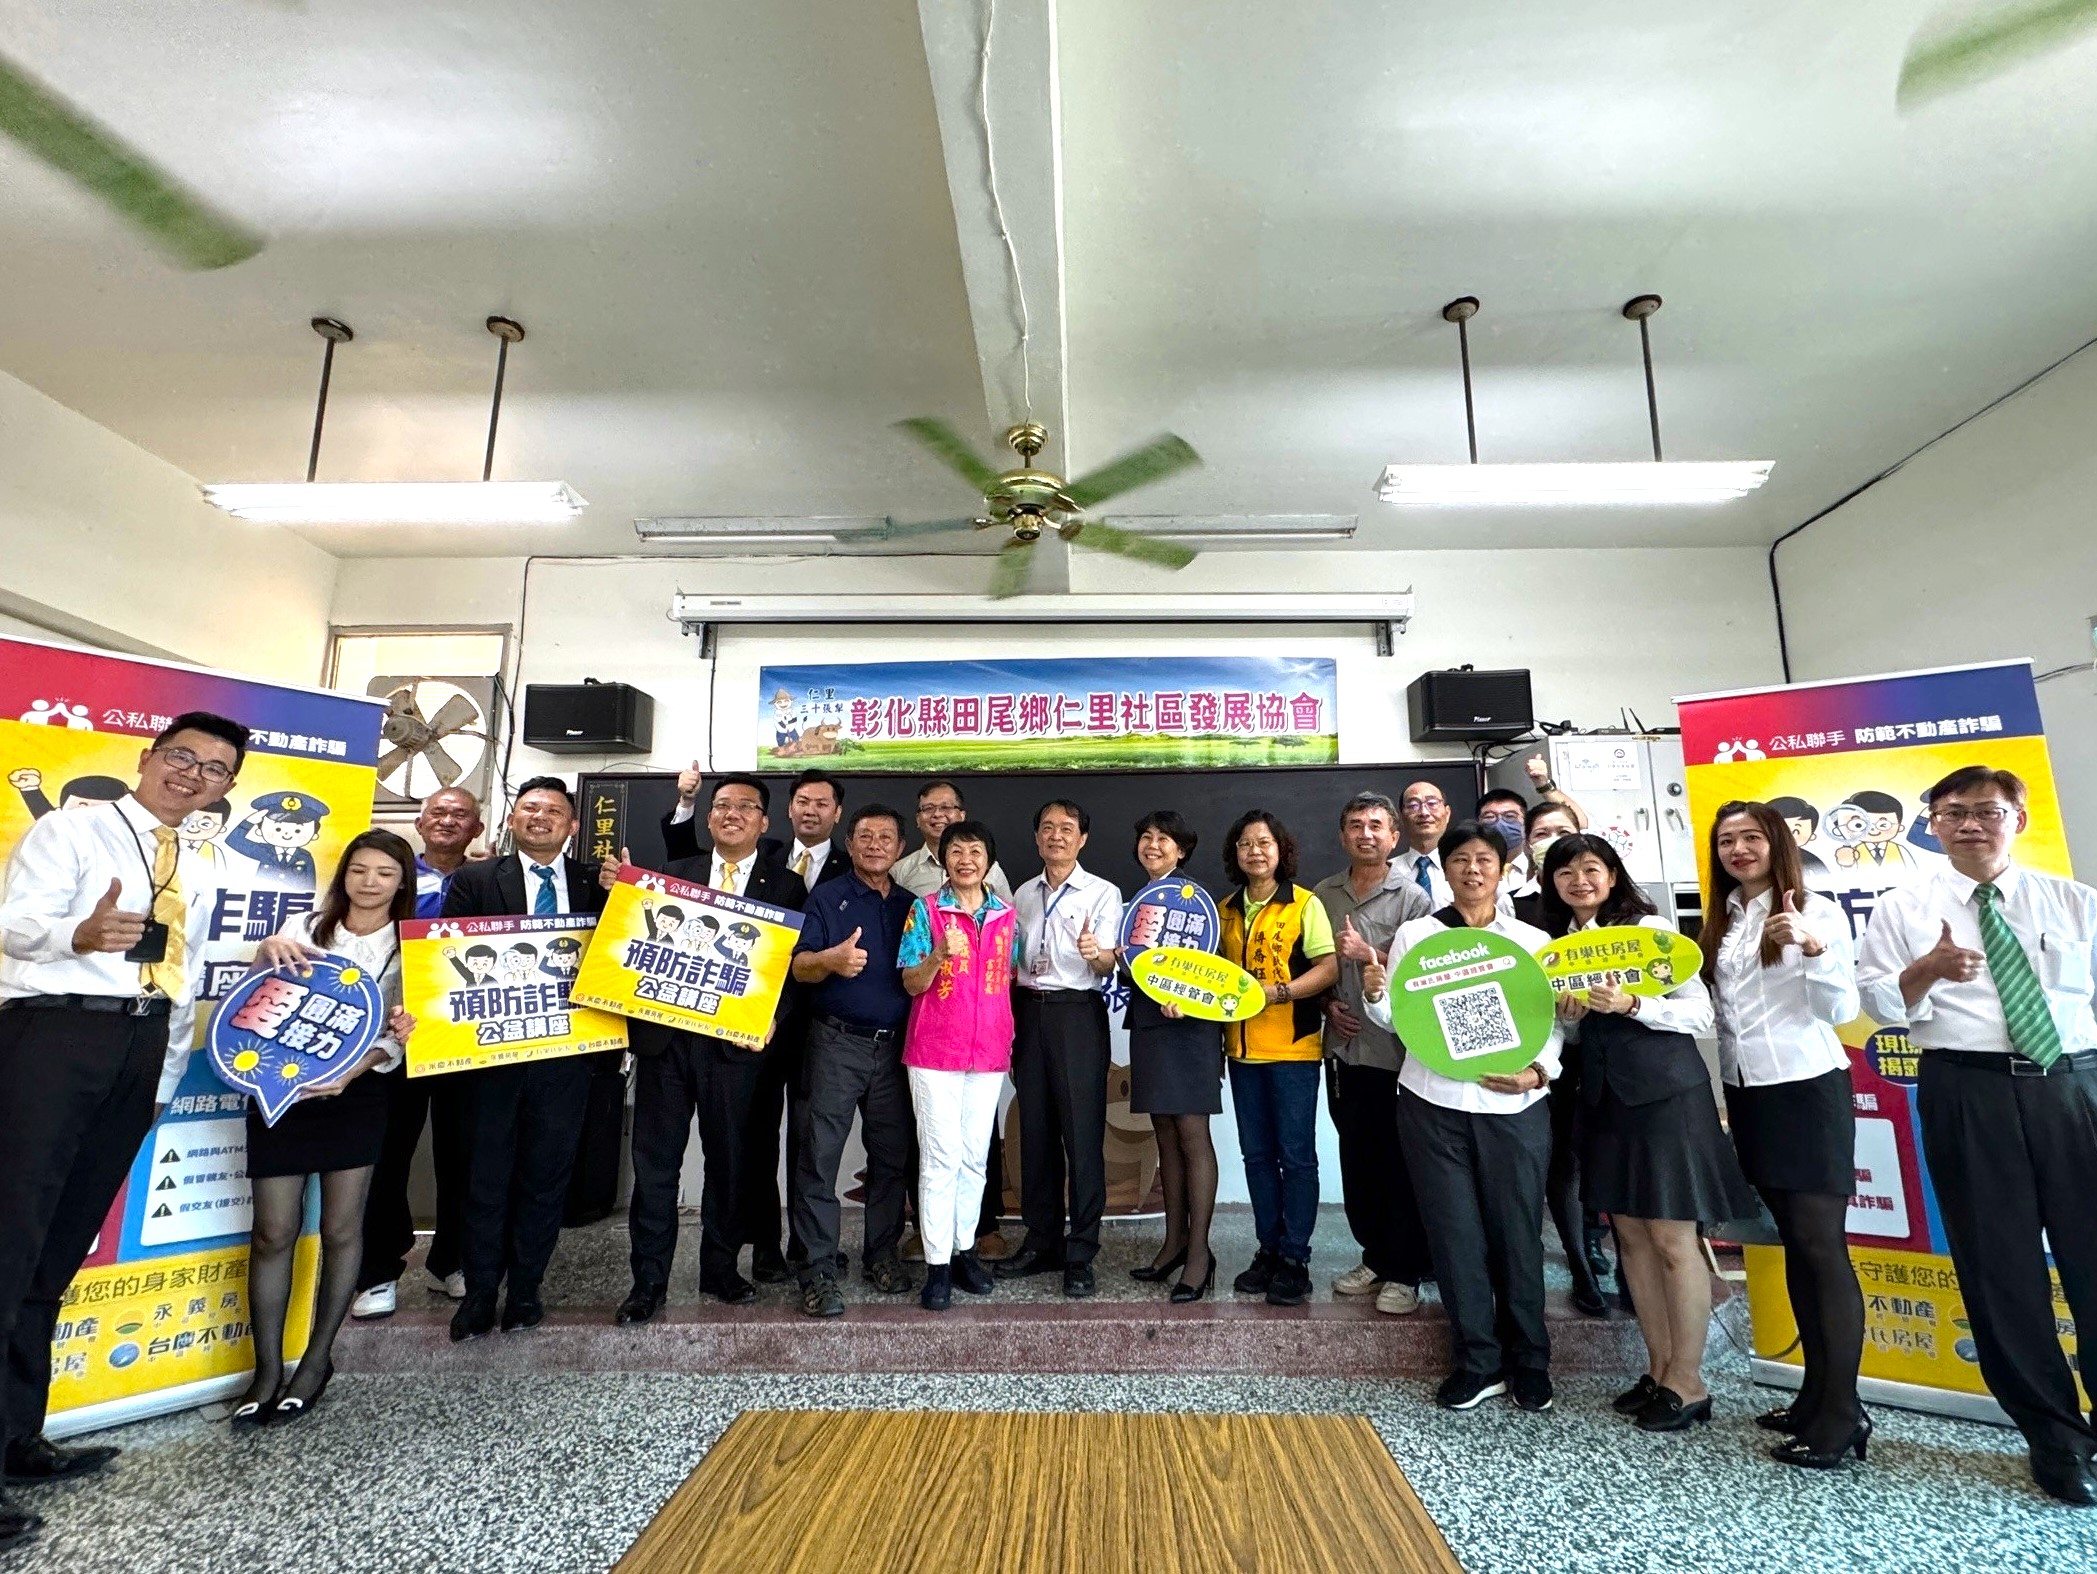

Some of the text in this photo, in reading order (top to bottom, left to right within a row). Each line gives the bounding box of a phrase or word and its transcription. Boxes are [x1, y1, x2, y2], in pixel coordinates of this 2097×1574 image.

[808, 688, 835, 700] 仁里
[850, 691, 1322, 738] 彰化縣田尾鄉仁里社區發展協會
[1768, 715, 2003, 752] 公私聯手 防範不動產詐騙
[669, 883, 711, 901] 公私聯手
[466, 921, 515, 933] 公私聯手
[1165, 908, 1208, 937] 圓滿
[1419, 942, 1490, 971] facebook
[1566, 939, 1642, 961] 有巢氏房屋
[622, 938, 752, 997] 預防詐騙
[634, 976, 722, 1015] 公益講座
[1147, 974, 1215, 1005] 中區經管會
[301, 993, 367, 1037] 圓滿
[277, 1019, 343, 1061] 接力
[477, 1014, 571, 1047] 公益講座
[170, 1093, 248, 1116] 網路電
[1868, 1294, 1936, 1318] 不動產
